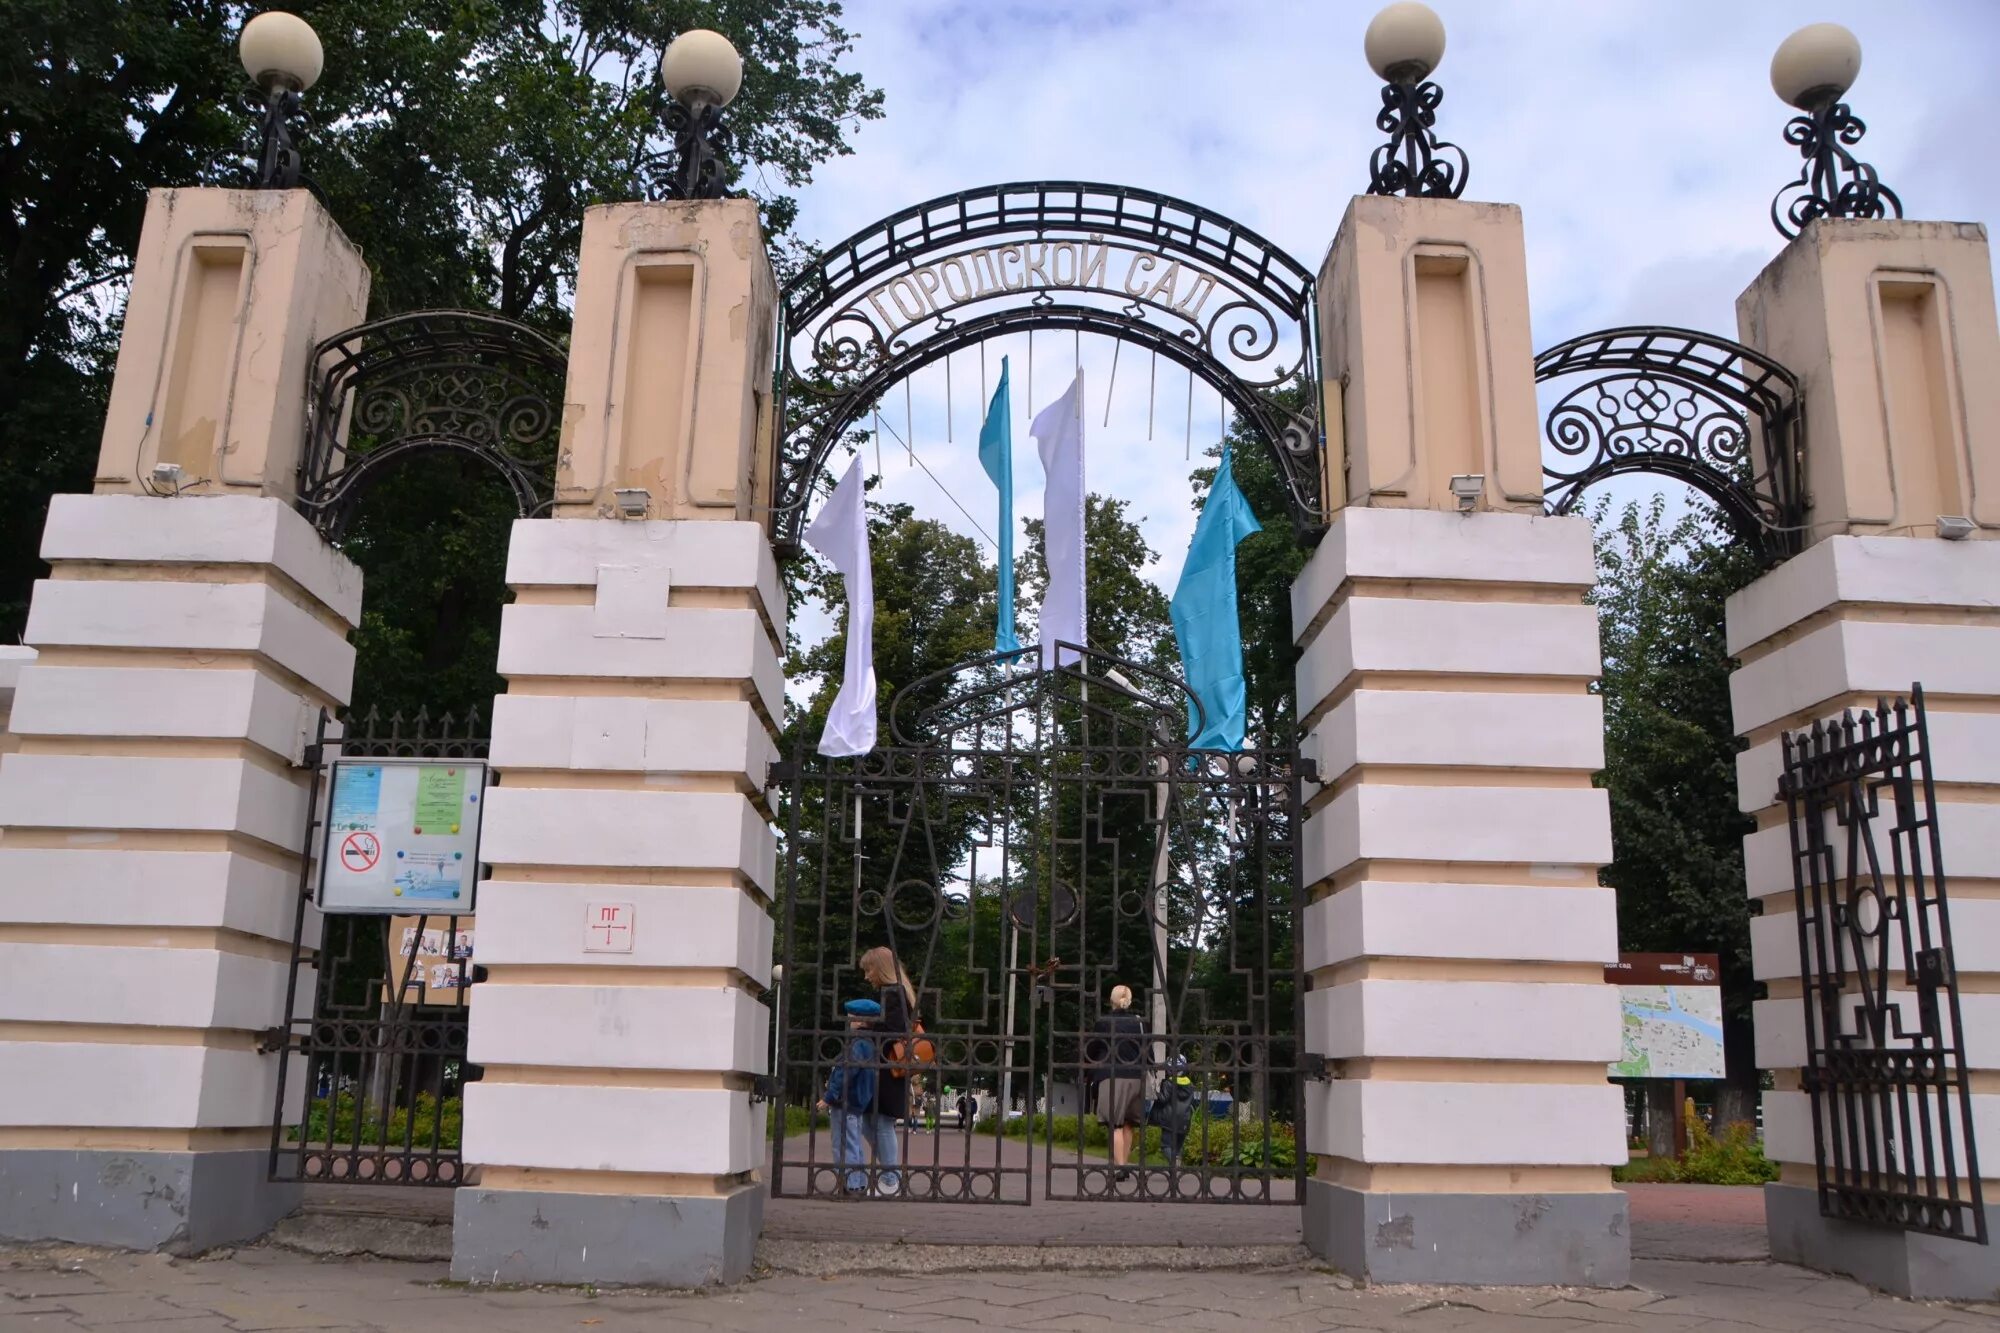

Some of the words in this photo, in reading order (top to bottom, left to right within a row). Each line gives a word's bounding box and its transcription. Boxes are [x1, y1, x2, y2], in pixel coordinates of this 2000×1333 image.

[866, 234, 1109, 333] ГОРОДСКОЙ
[1124, 251, 1218, 321] САД
[601, 907, 620, 921] ПГ
